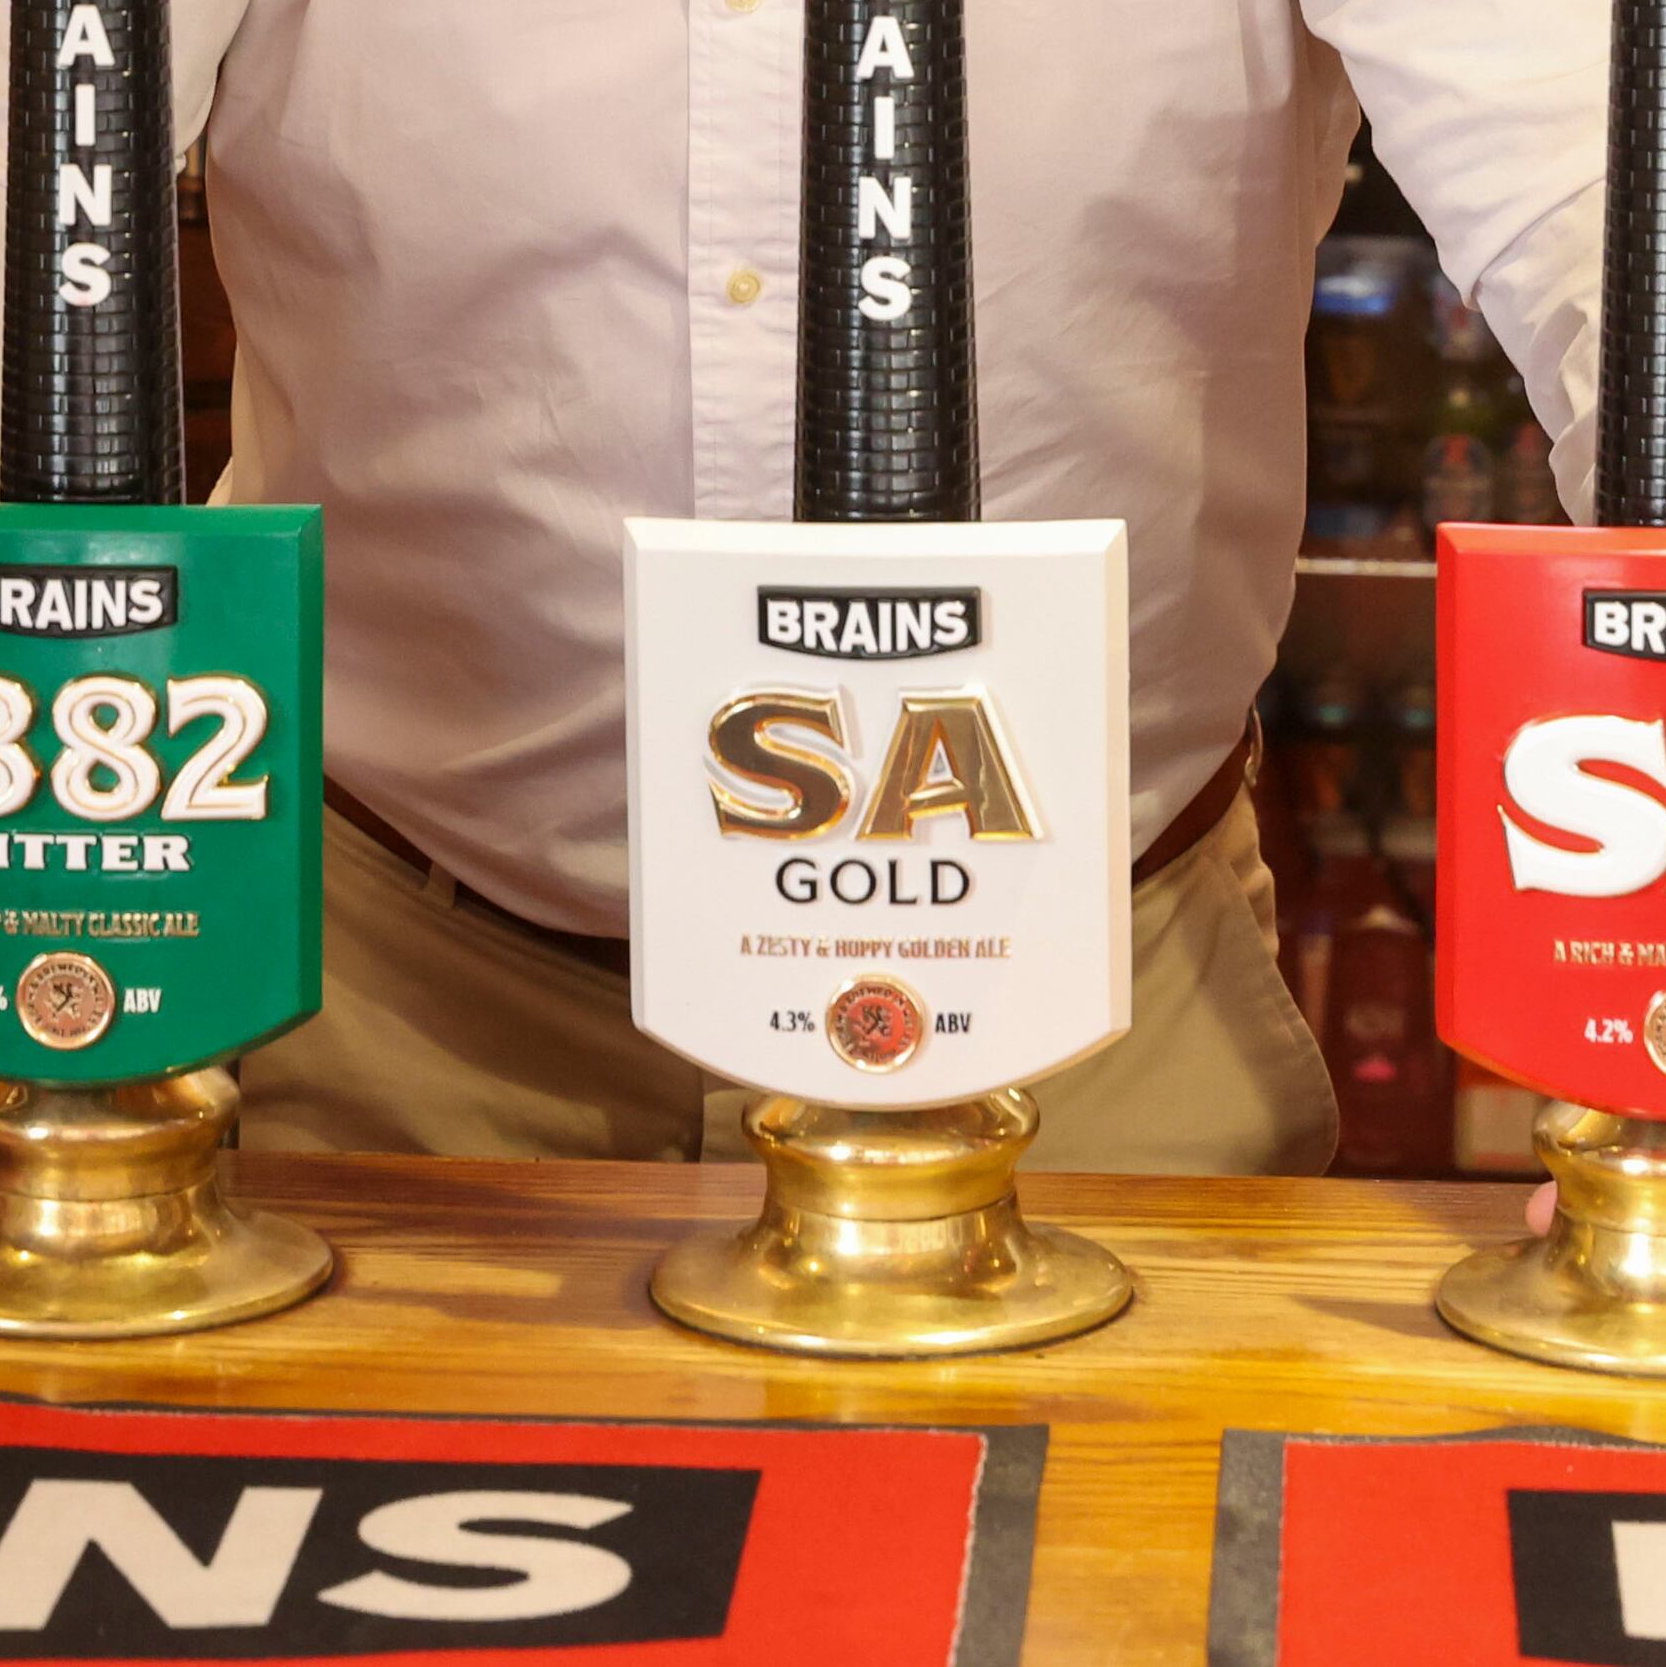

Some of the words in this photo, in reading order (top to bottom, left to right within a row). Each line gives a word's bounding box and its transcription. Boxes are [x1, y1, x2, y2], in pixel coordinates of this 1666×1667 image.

[766, 599, 969, 654] BRAINS
[705, 684, 1045, 841] SA
[774, 856, 973, 906] GOLD
[4, 909, 20, 936] &
[22, 909, 86, 936] MALTY
[87, 911, 161, 938] CLASSIC
[162, 911, 201, 938] ALE
[740, 934, 753, 956] A
[756, 935, 811, 957] ZESTY
[816, 939, 830, 958] &
[834, 937, 893, 959] HOPPY
[897, 938, 972, 959] GOLDEN
[974, 937, 1012, 959] ALE
[1553, 938, 1567, 964] A
[1569, 939, 1616, 966] RICH
[1617, 941, 1635, 967] &
[122, 986, 162, 1014] ABV
[769, 1009, 815, 1033] 4.3%
[935, 1011, 973, 1035] ABV
[1583, 1017, 1634, 1046] 4.2%
